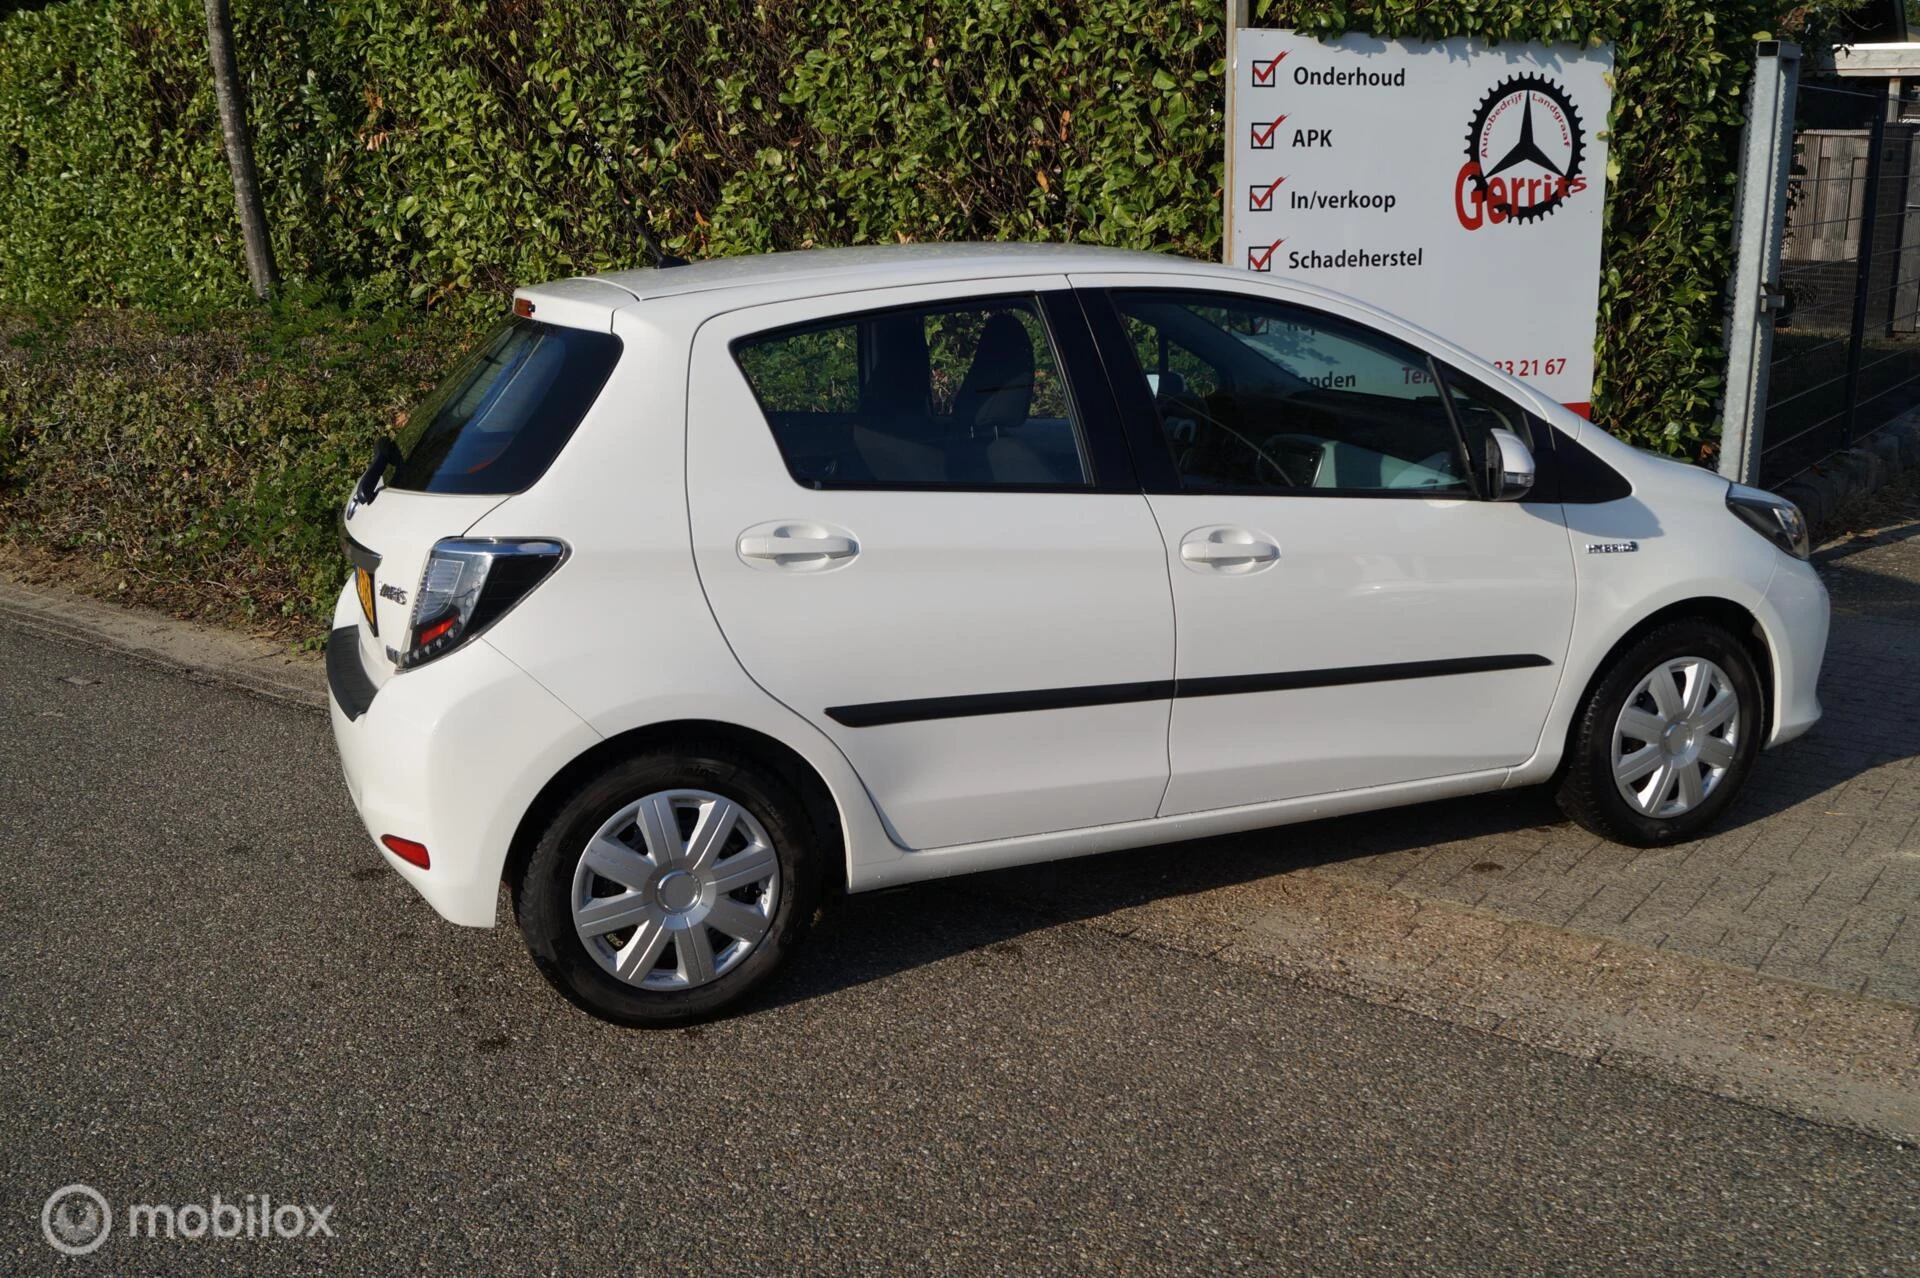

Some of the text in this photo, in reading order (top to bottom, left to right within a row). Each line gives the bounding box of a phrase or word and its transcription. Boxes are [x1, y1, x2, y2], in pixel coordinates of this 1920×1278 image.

[1293, 66, 1405, 87] Onderhoud
[1481, 93, 1522, 158] Autobedrijf
[1532, 93, 1570, 148] Landgraaf
[1292, 128, 1332, 148] APK
[1290, 189, 1396, 212] In/verkoop
[1455, 161, 1587, 231] Gerrits
[1288, 248, 1422, 269] Schadeherstel
[1519, 360, 1538, 376] 21
[1545, 358, 1567, 375] 67
